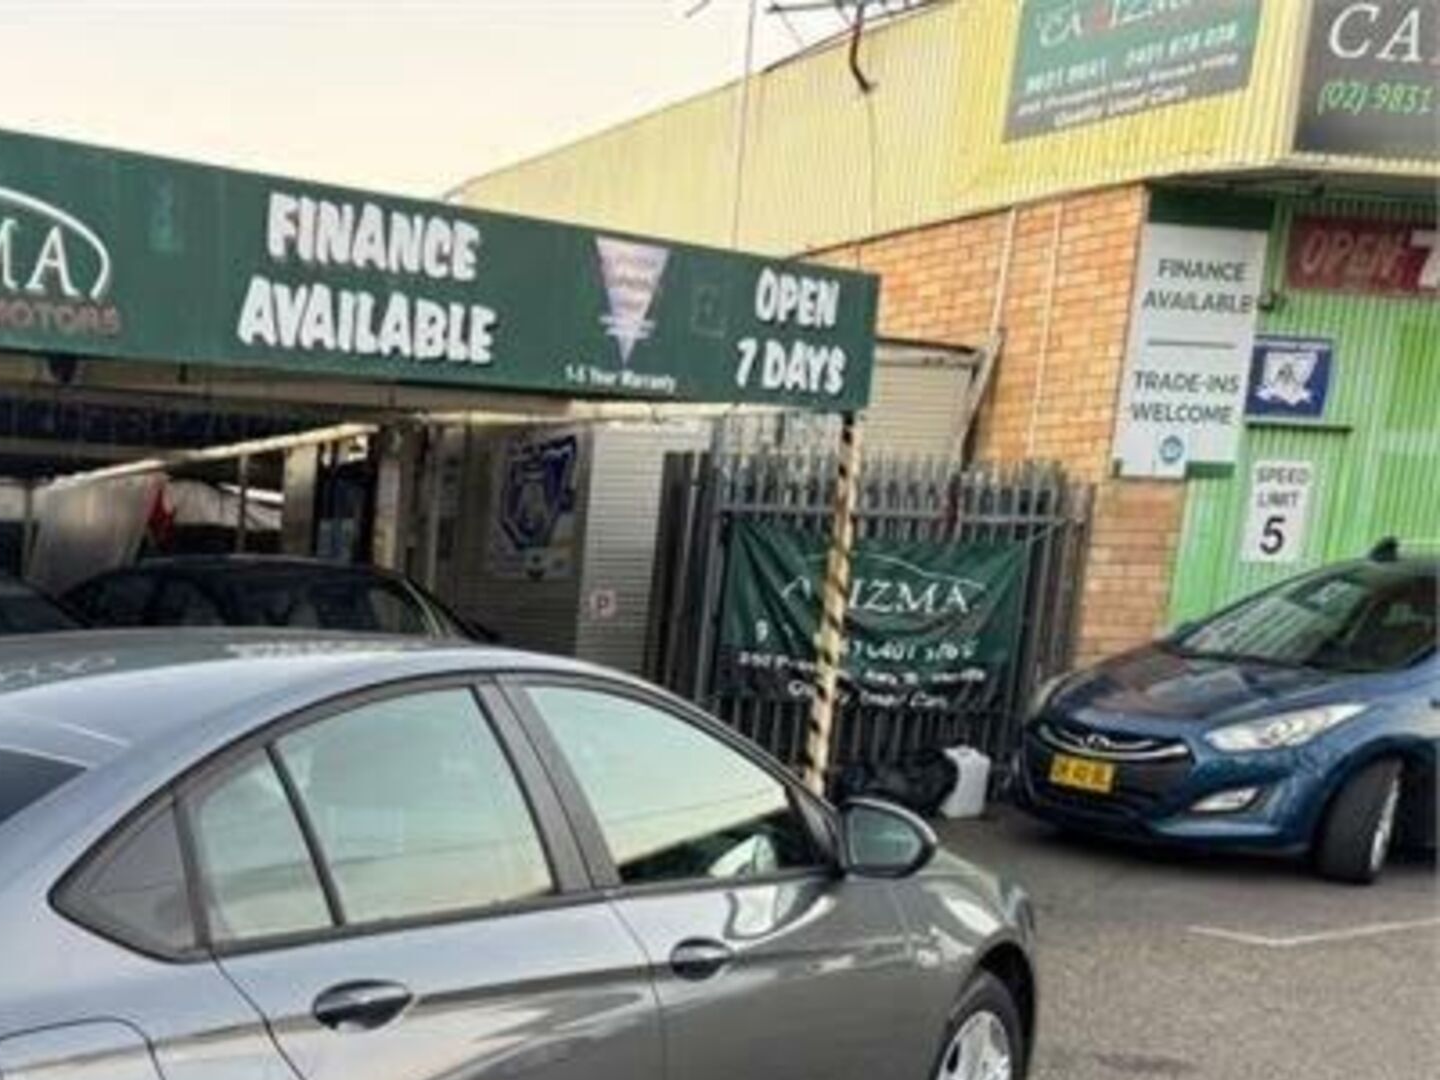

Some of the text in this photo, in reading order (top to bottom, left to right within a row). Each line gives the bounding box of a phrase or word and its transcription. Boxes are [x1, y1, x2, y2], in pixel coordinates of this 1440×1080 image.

[1328, 2, 1440, 63] CA
[266, 191, 481, 282] FINANCE
[1157, 257, 1247, 282] FINANCE
[236, 276, 498, 365] AVAILABLE
[754, 267, 840, 329] OPEN
[1142, 289, 1253, 313] AVAILABLE
[736, 337, 848, 395] 7 DAYS
[1133, 370, 1241, 394] TRADE-INS
[1130, 402, 1233, 425] WELCOME
[1259, 514, 1287, 556] 5
